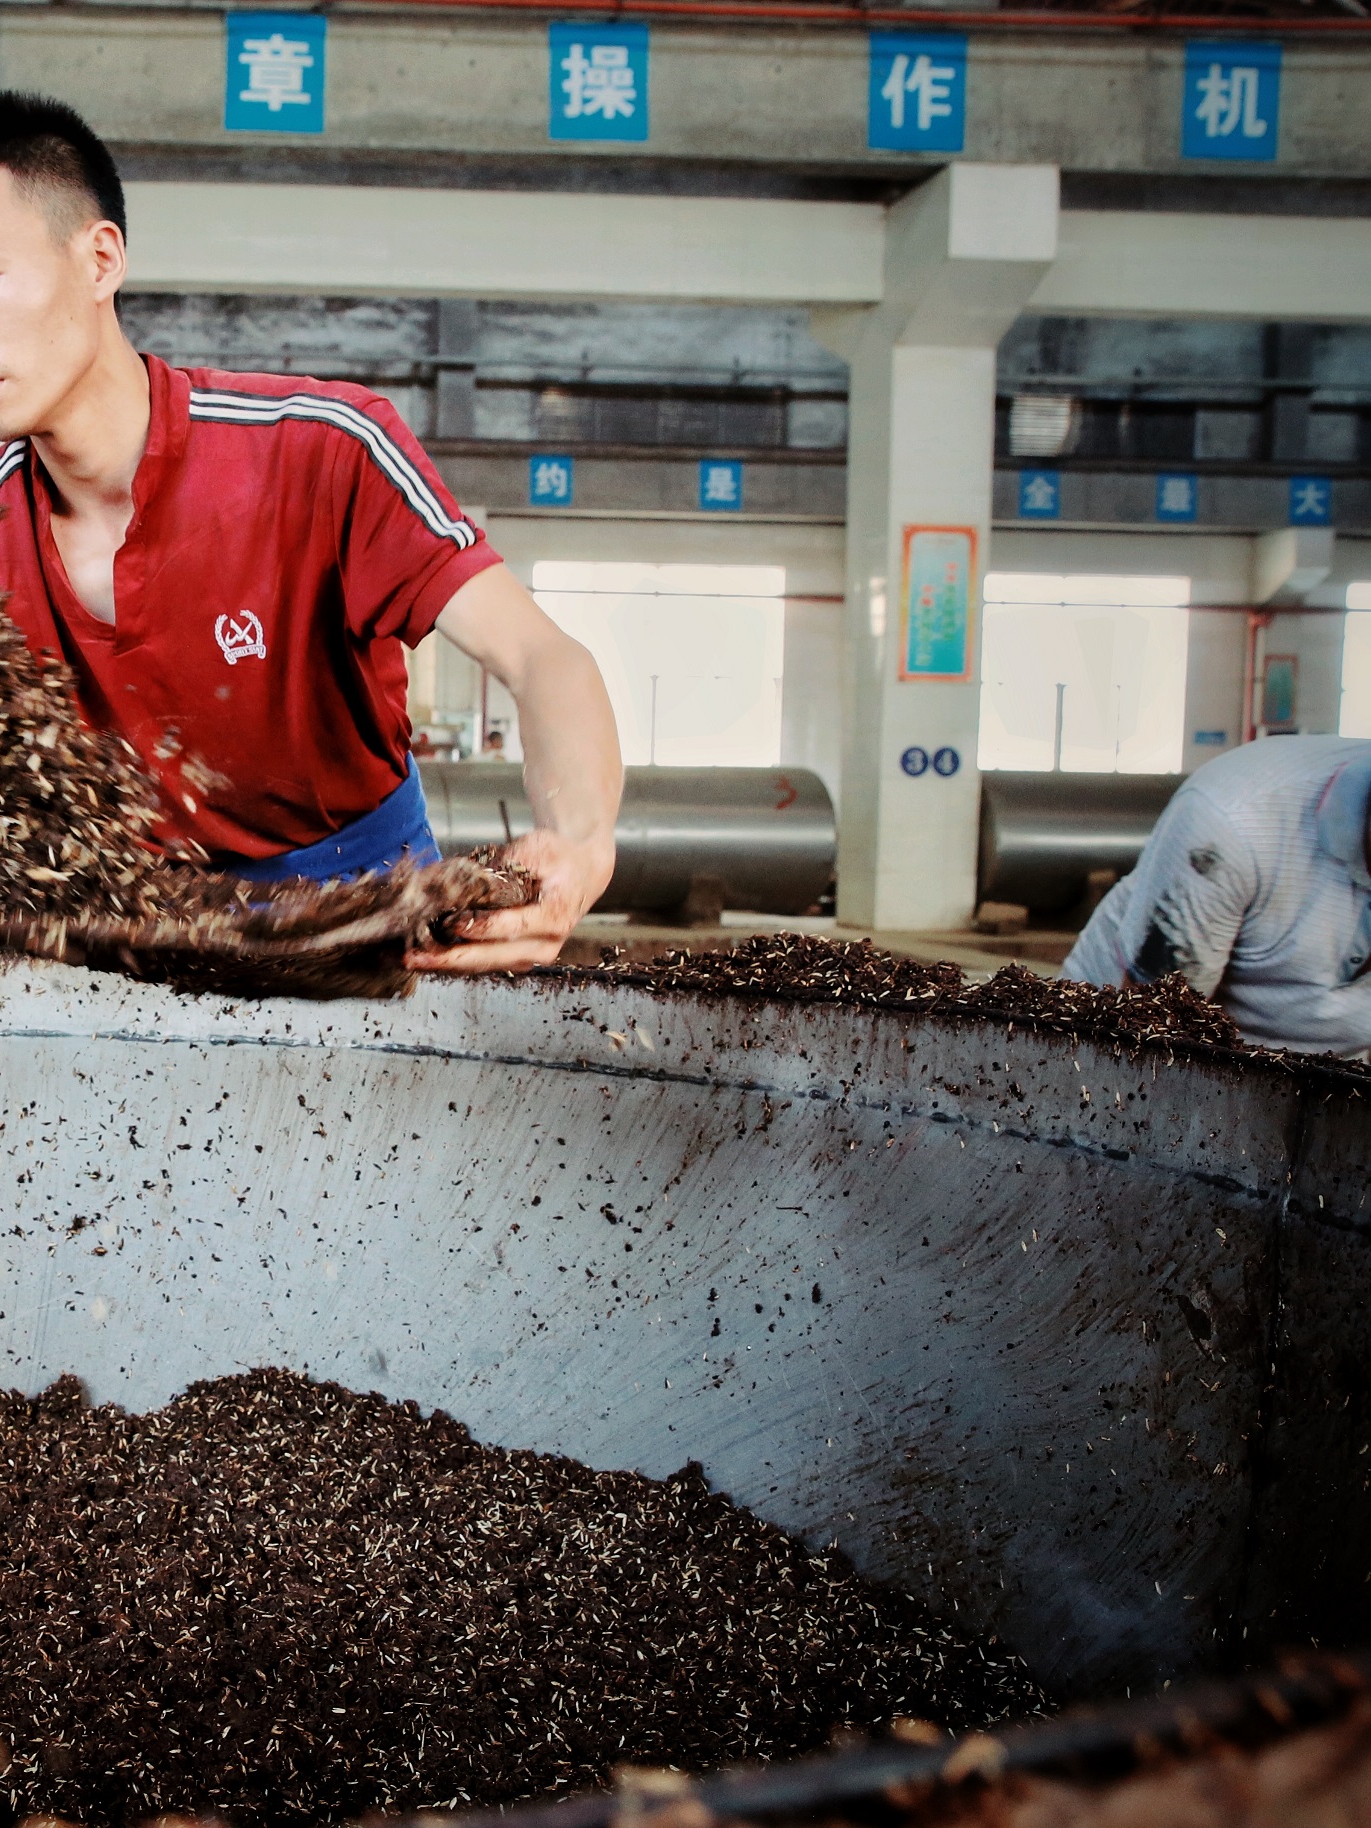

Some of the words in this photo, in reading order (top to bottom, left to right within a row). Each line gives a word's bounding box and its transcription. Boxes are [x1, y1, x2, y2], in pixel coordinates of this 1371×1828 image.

[238, 33, 314, 111] 章
[561, 44, 636, 120] 操
[882, 55, 953, 130] 作
[1196, 64, 1267, 138] 机
[535, 463, 568, 498] 约
[705, 467, 736, 501] 是
[1294, 482, 1326, 515] 大
